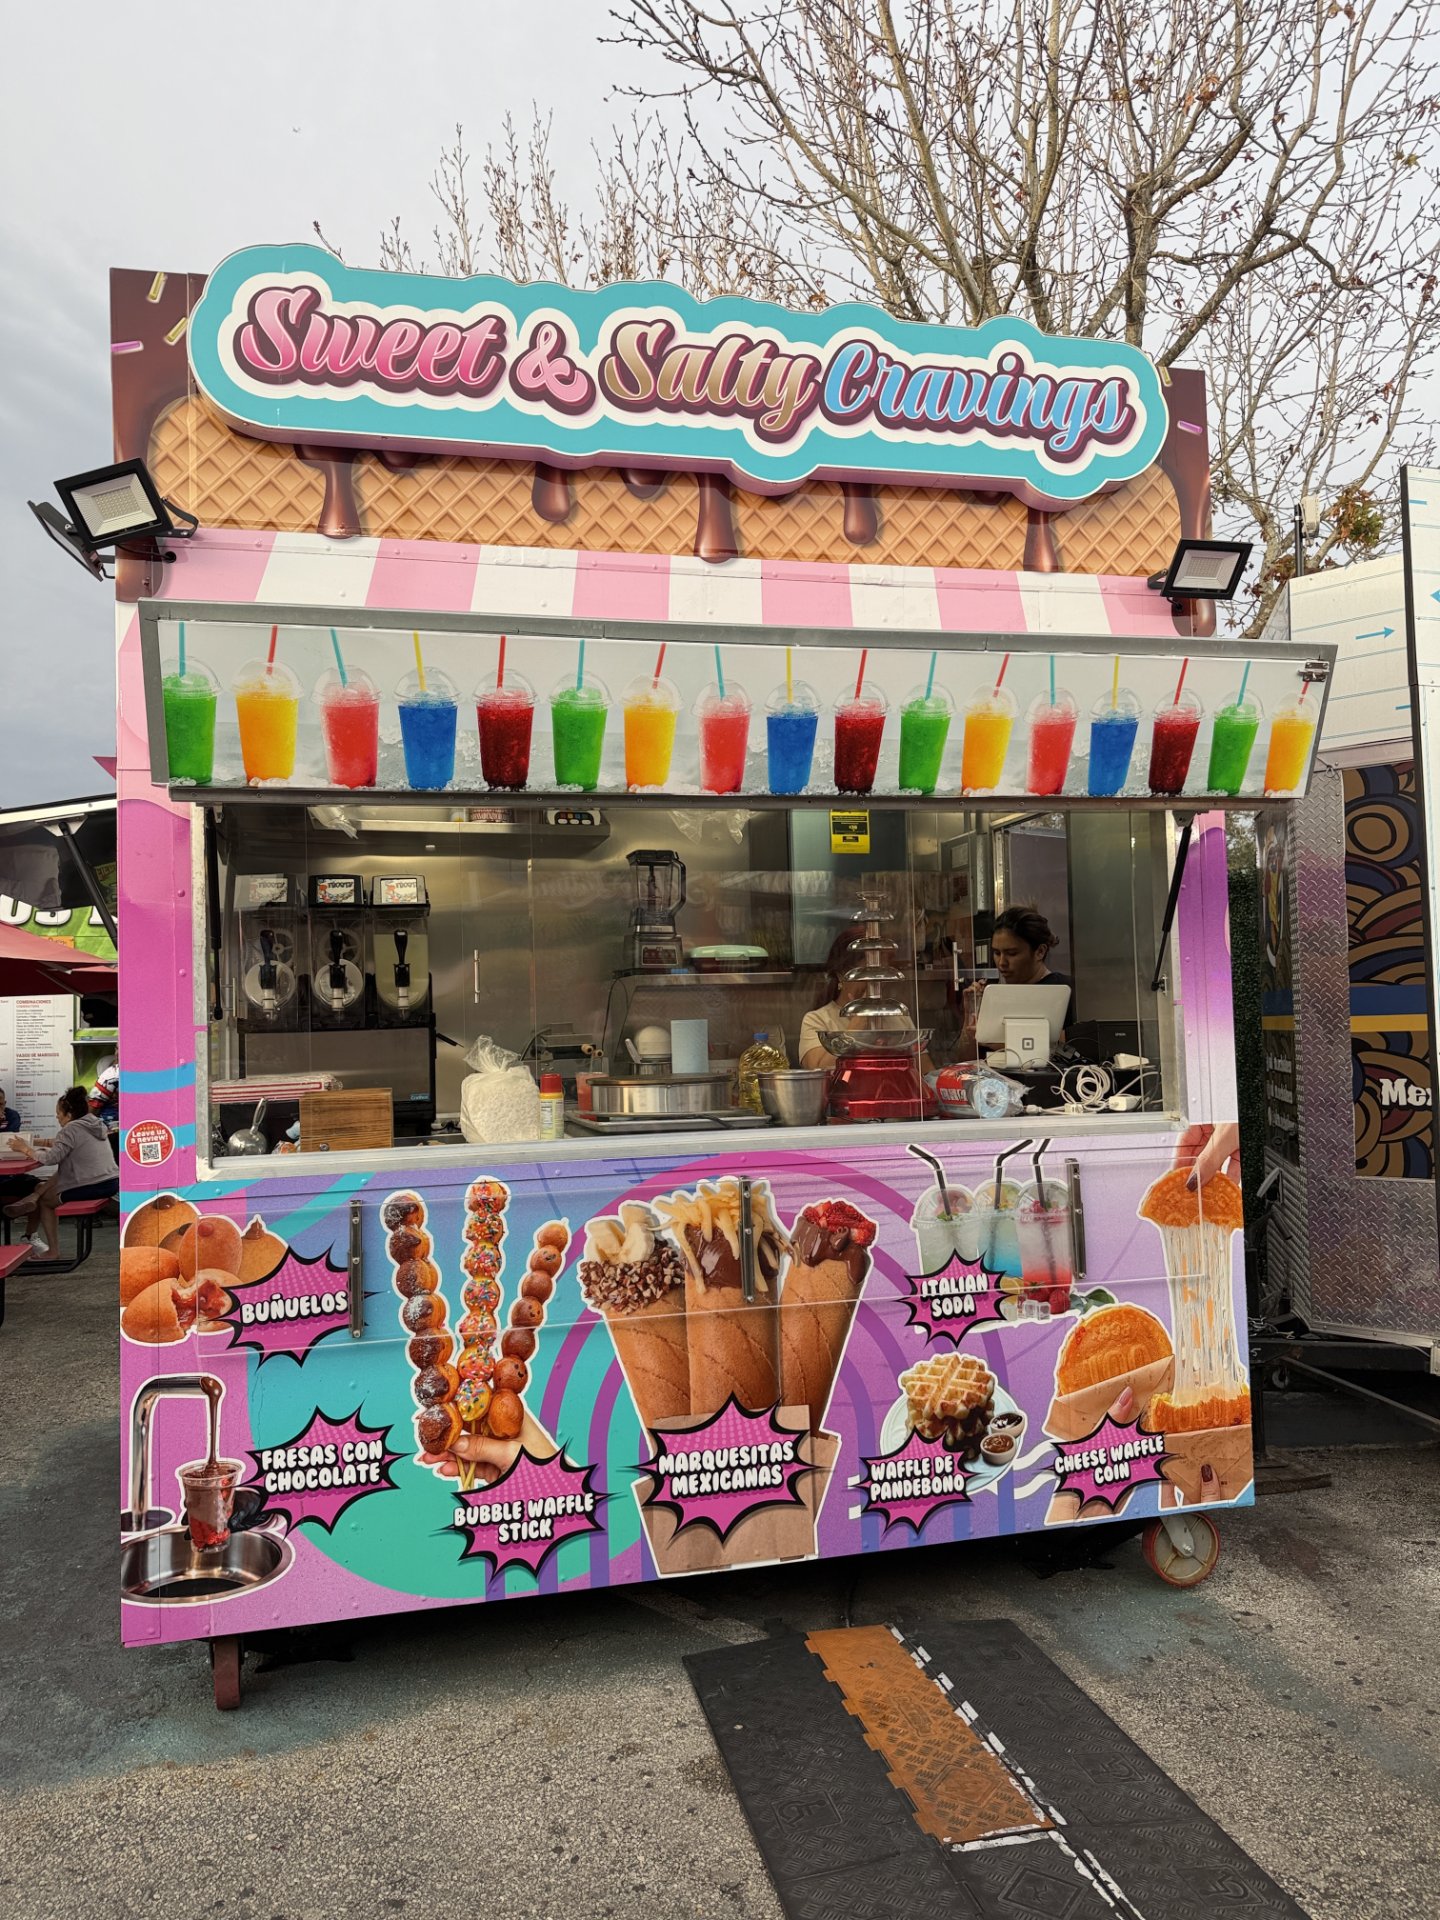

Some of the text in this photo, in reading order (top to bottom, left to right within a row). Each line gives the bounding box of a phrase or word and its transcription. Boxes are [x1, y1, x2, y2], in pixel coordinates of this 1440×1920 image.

[236, 286, 1132, 457] Sweet & Salty Cravings
[132, 1130, 155, 1138] Leave
[921, 1273, 988, 1297] ITALIAN
[241, 1292, 348, 1325] BUÑUELOS
[931, 1295, 976, 1318] SODA
[262, 1440, 383, 1472] FRESAS CON
[658, 1441, 795, 1475] MARQUESITAS
[870, 1455, 953, 1481] WAFFLE DE
[1054, 1435, 1164, 1474] CHEESE WAFFLE
[264, 1462, 381, 1492] CHOCOLATE
[671, 1465, 783, 1497] MEXICANAS
[870, 1474, 965, 1501] PANDEBONO
[1094, 1462, 1130, 1484] COIN
[454, 1493, 594, 1526] BUBBLE WAFFLE
[498, 1517, 553, 1543] STICK
